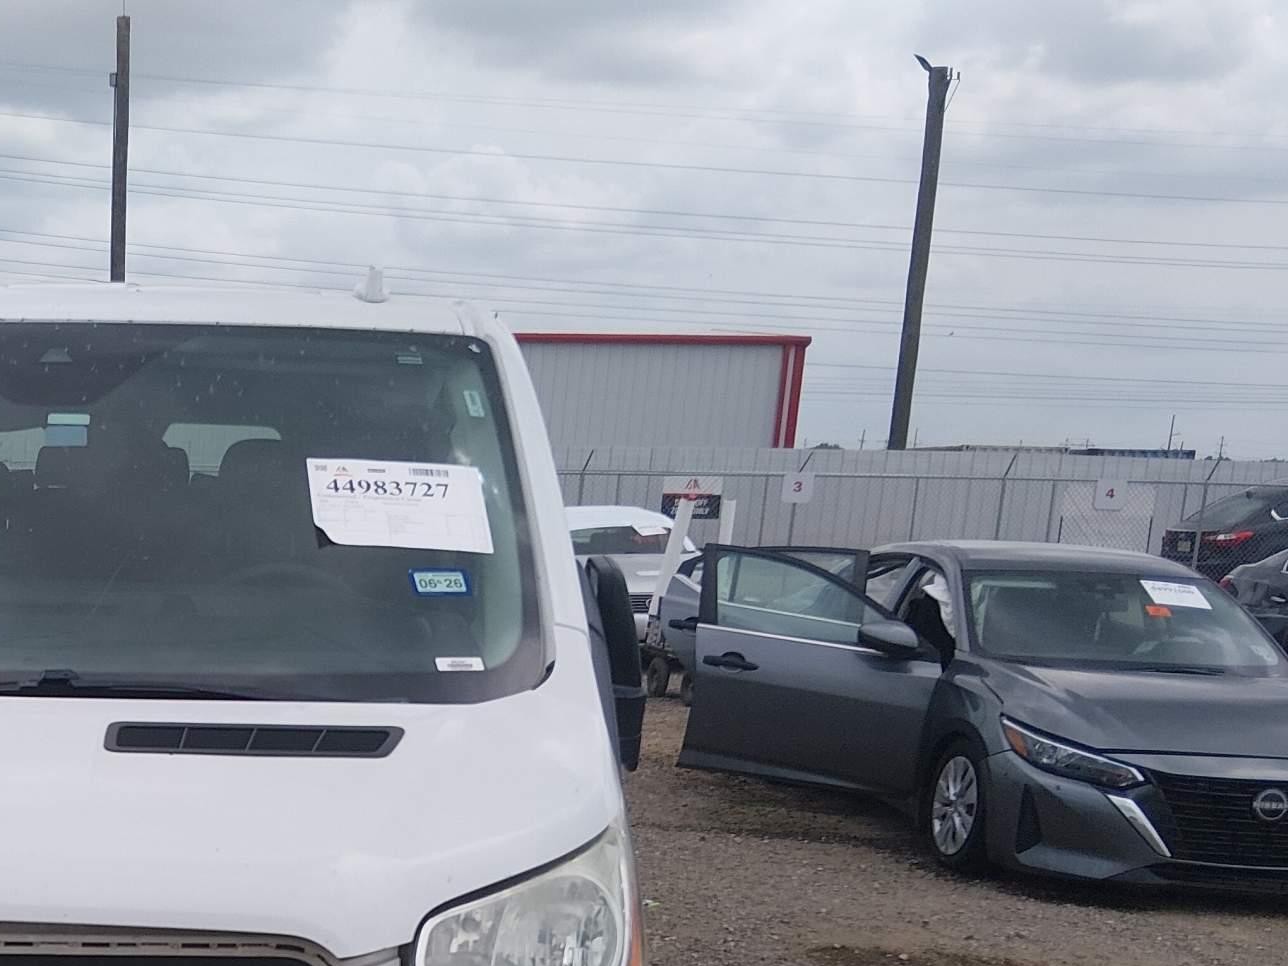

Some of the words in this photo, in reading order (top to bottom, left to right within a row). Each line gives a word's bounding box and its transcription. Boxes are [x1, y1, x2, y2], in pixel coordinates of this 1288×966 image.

[326, 479, 449, 499] 44983727
[793, 481, 803, 493] 3
[1105, 488, 1115, 499] 4
